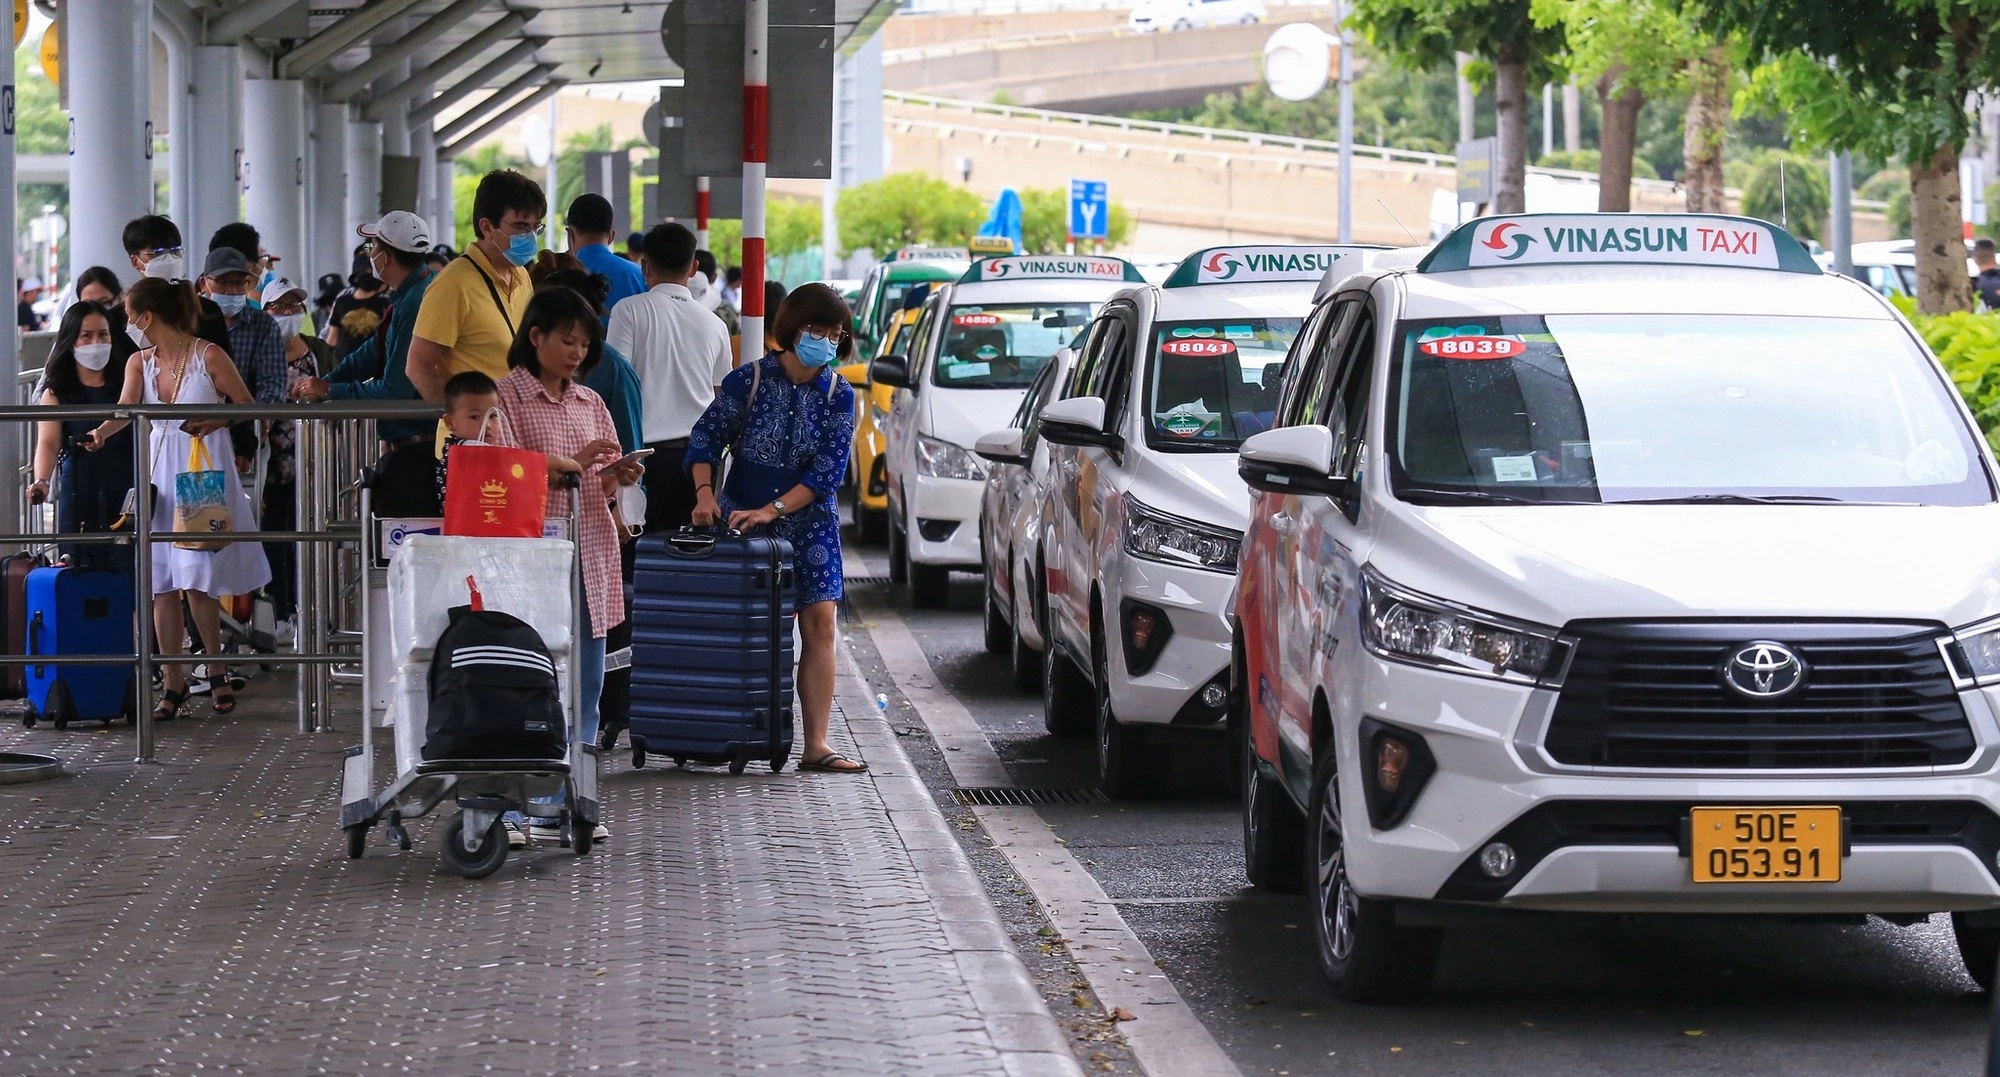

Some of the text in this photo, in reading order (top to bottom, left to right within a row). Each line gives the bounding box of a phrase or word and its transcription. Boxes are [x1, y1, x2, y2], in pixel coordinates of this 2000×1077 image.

[1544, 226, 1759, 255] VINASUN TAXI
[1019, 261, 1120, 276] VINASUN TAXI
[1244, 253, 1349, 272] VINASU
[1168, 342, 1229, 354] 18041
[1425, 340, 1512, 355] 18039
[209, 519, 227, 532] Sun
[1735, 812, 1798, 843] 50E
[1709, 847, 1820, 878] 053.91
